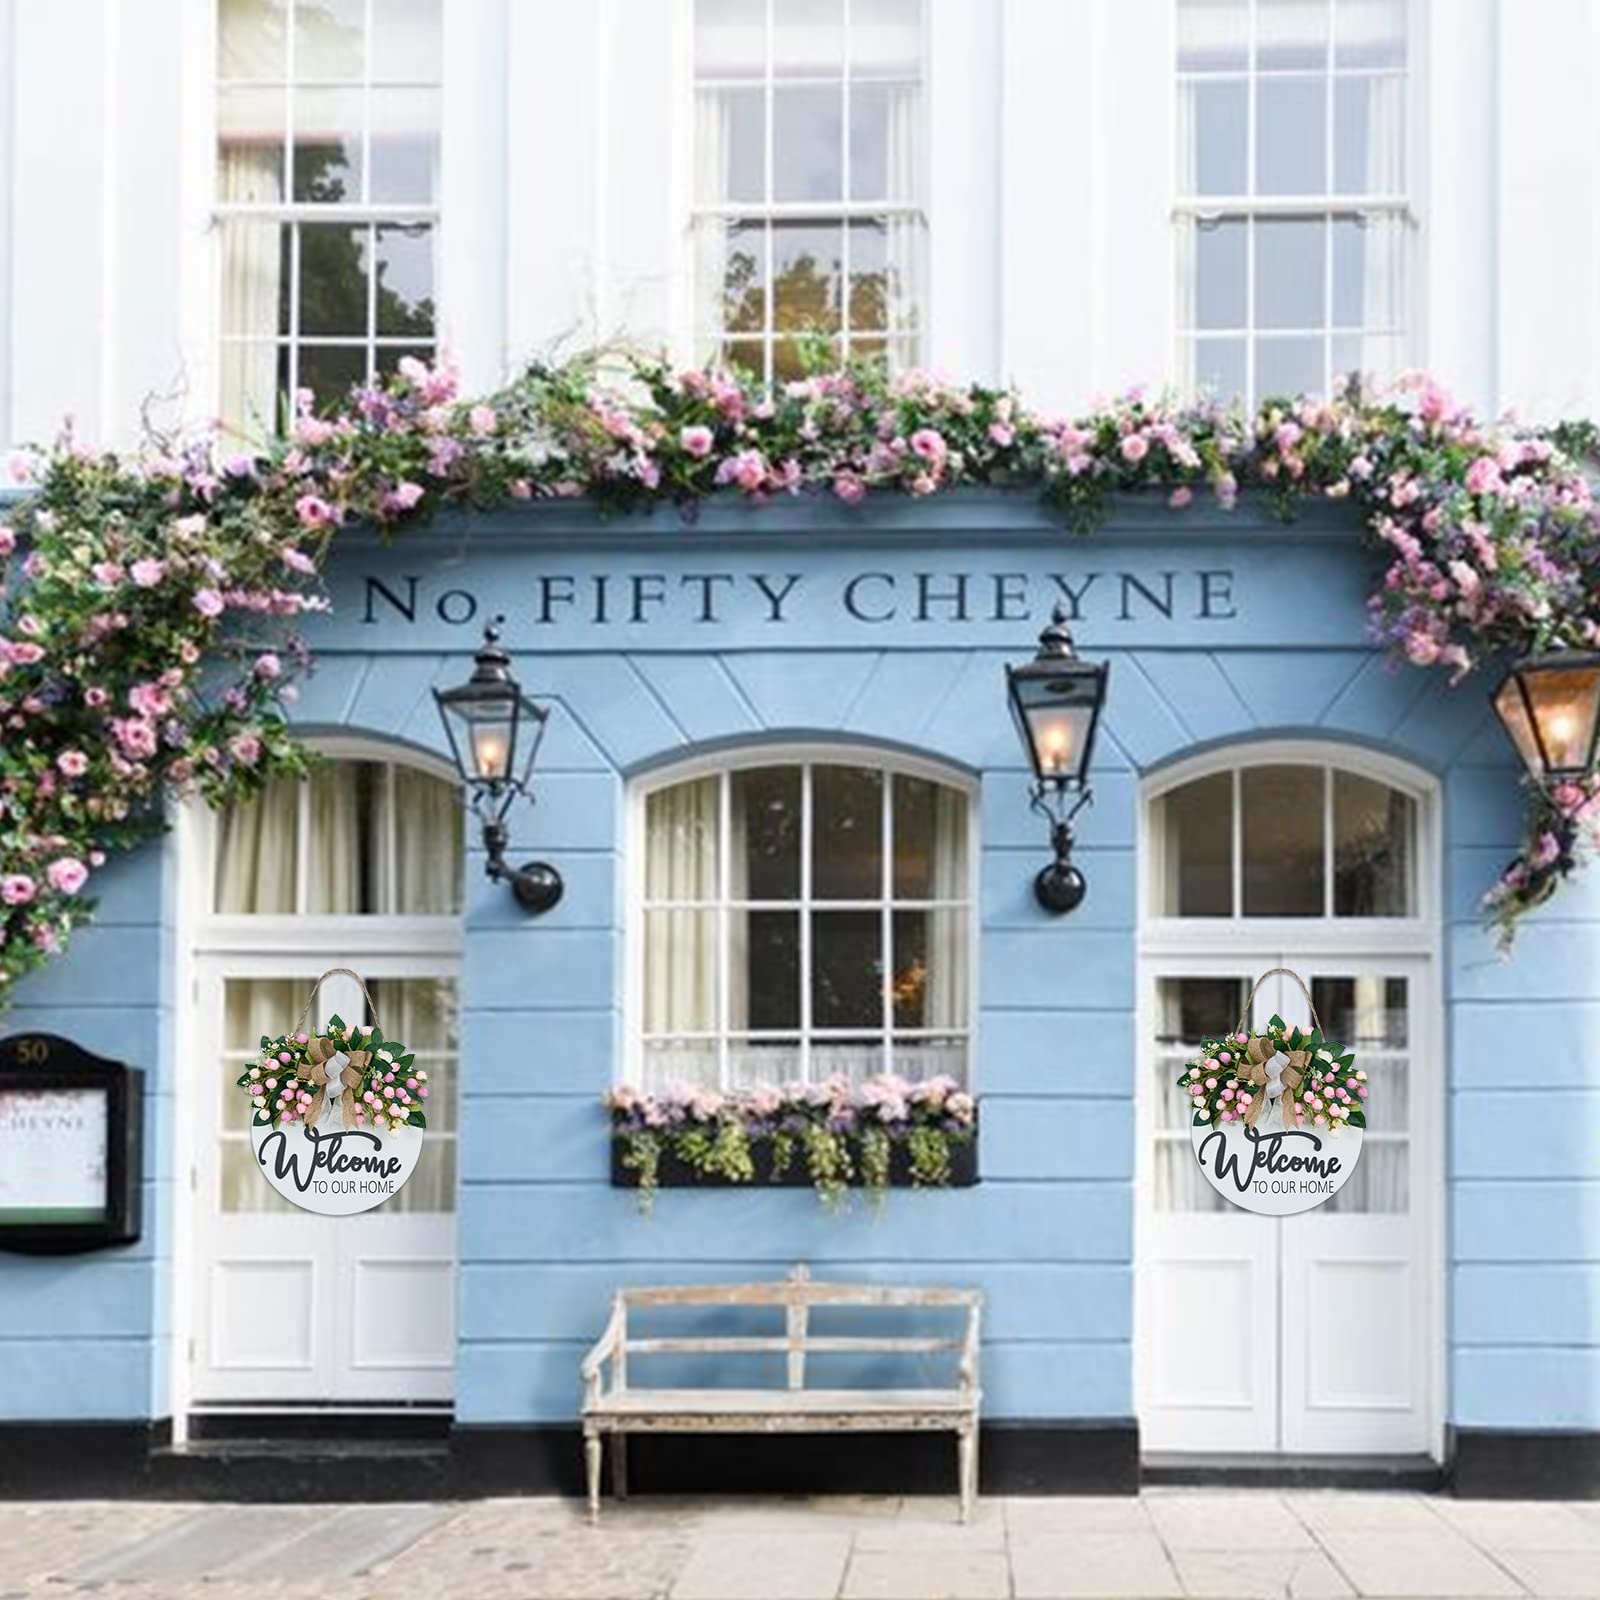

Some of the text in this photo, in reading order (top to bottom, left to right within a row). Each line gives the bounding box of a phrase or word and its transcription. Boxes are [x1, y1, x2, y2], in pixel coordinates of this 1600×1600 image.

[361, 570, 1239, 625] No. FIFTY CHEYNE
[17, 1041, 49, 1063] 50
[258, 1125, 402, 1192] Welcome
[1198, 1125, 1342, 1192] Welcome
[313, 1180, 395, 1194] TO OUR HOME
[1253, 1180, 1335, 1194] TO OUR HOME
